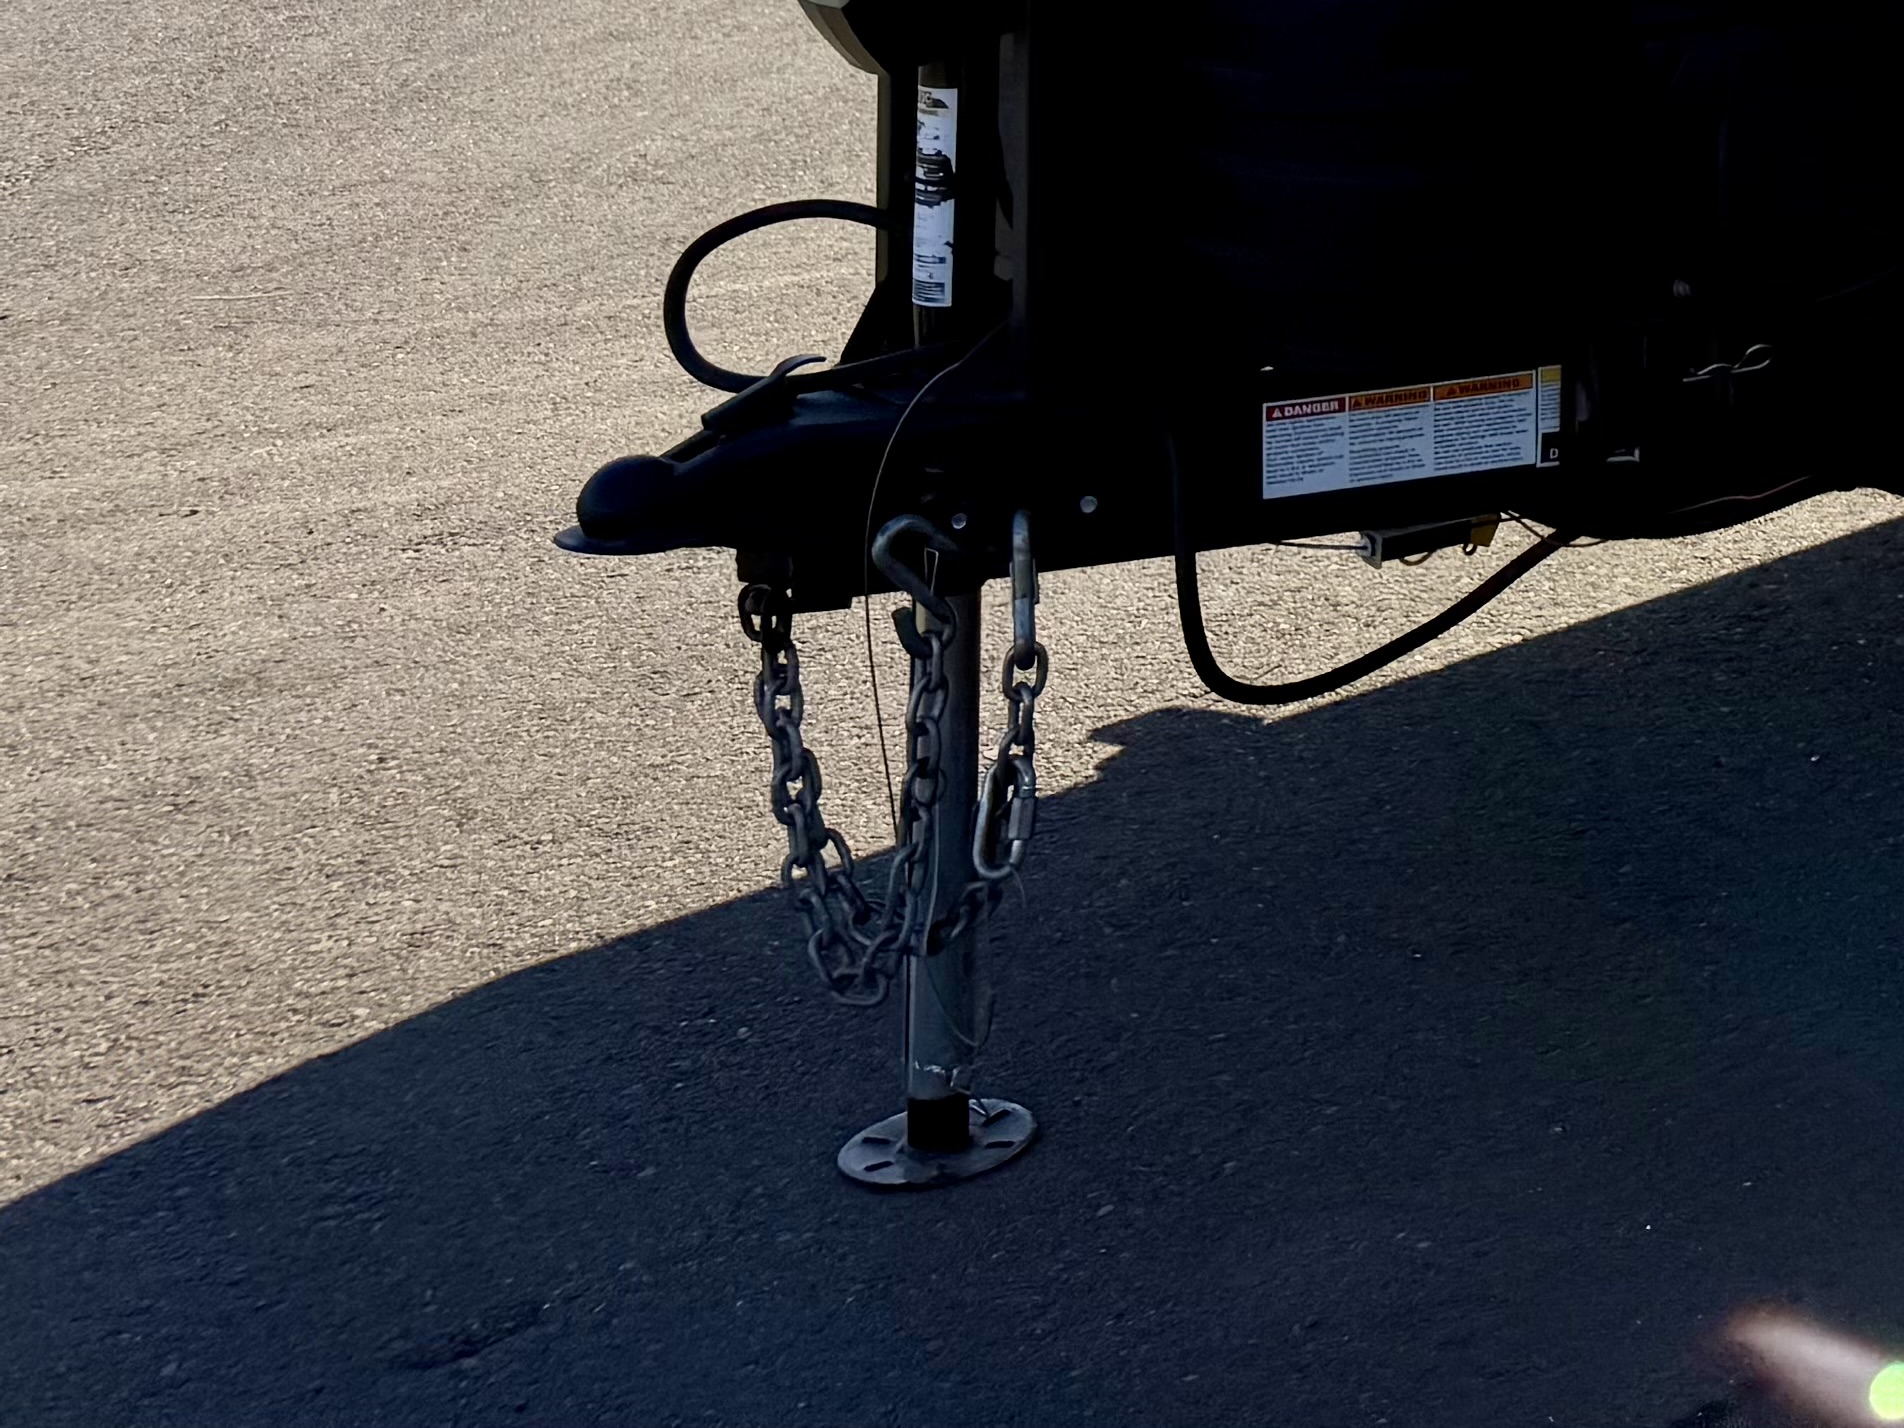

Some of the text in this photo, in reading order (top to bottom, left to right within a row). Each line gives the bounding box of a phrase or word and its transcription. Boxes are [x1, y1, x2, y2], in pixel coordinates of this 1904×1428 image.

[1458, 378, 1520, 395] WARNING
[1364, 390, 1428, 406] WARNING
[1284, 400, 1340, 418] DANGER
